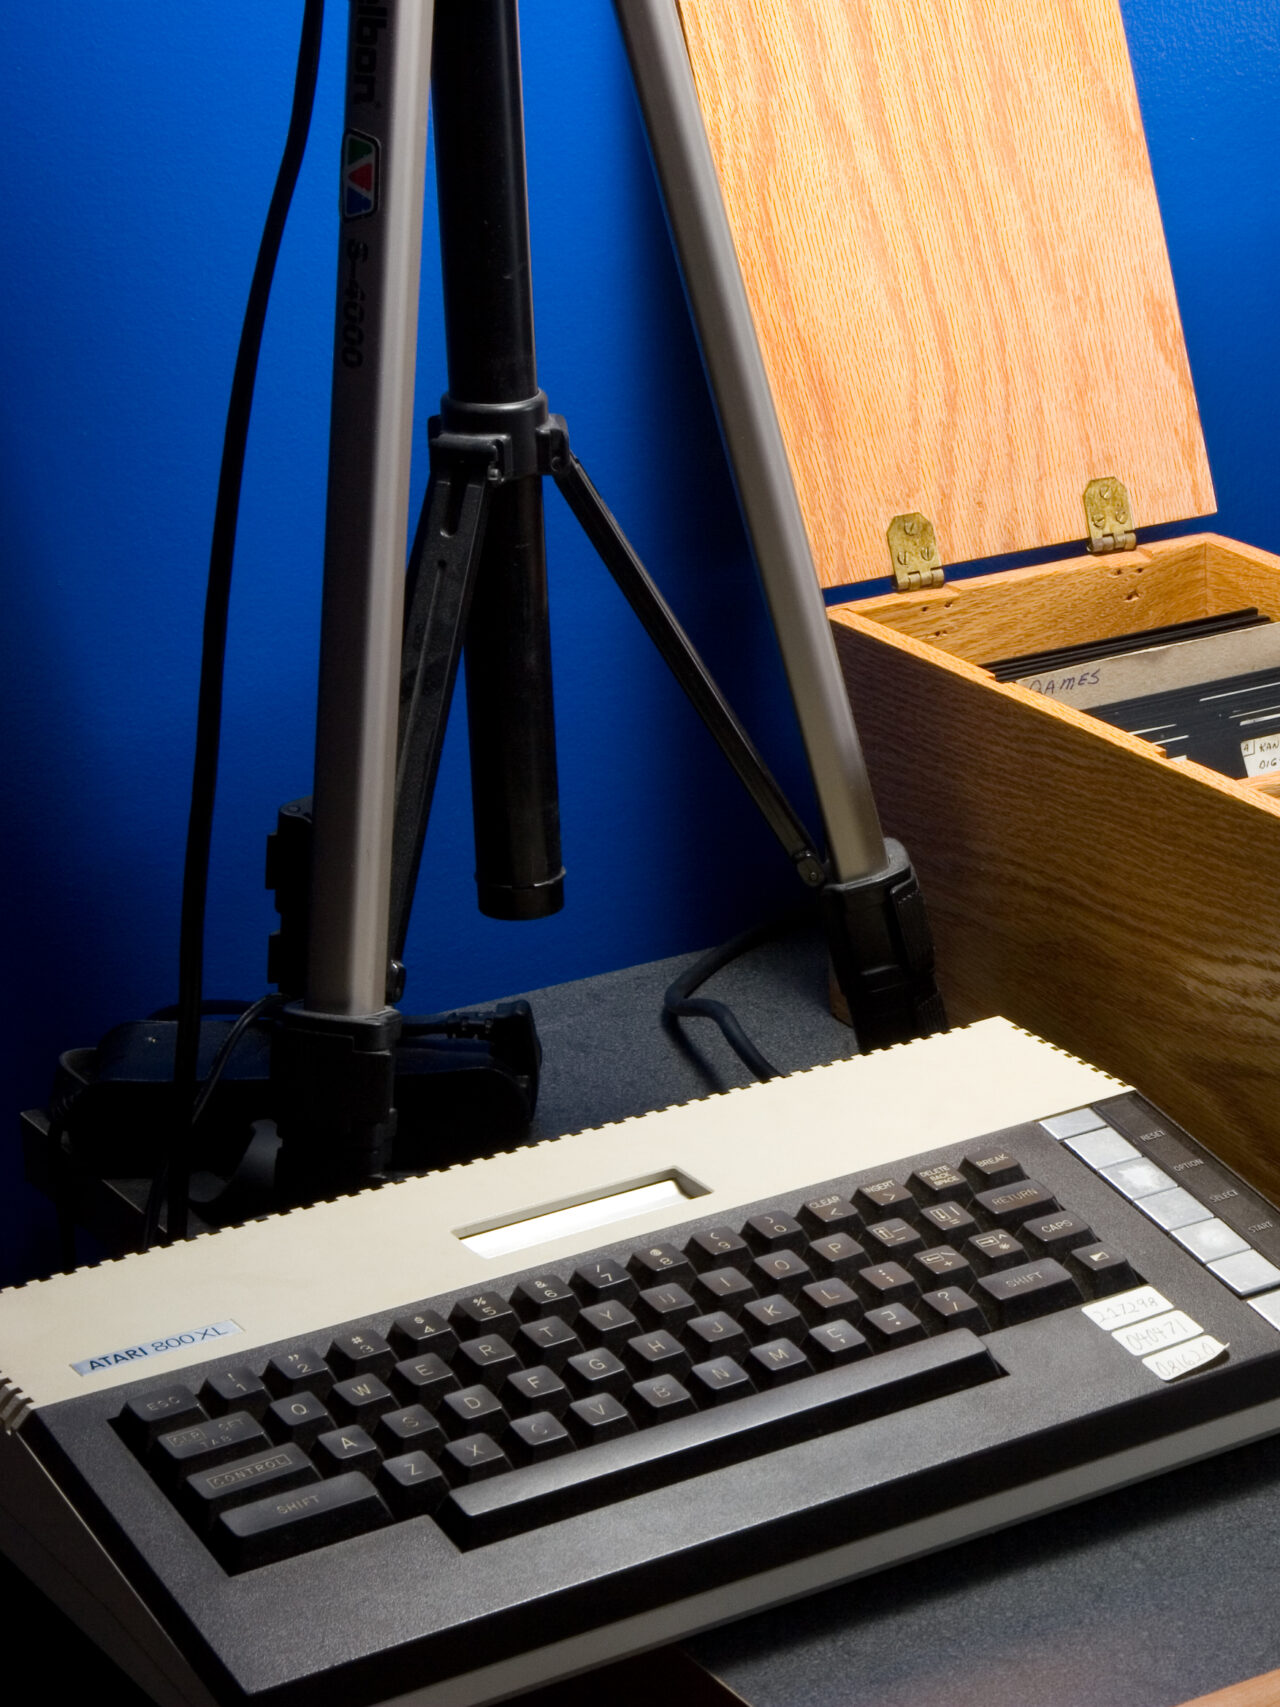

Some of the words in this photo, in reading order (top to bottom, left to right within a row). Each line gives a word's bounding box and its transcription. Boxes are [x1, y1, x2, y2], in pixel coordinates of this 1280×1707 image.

[1140, 1129, 1165, 1142] RESET
[976, 1153, 1008, 1167] BREAK
[1174, 1158, 1204, 1172] OPTION
[920, 1165, 949, 1177] DELETE
[930, 1171, 951, 1181] BACK
[863, 1180, 895, 1193] INSERT
[934, 1175, 960, 1186] SPACE
[809, 1195, 840, 1209] CLEAR
[992, 1188, 1038, 1206] RETURN
[1211, 1189, 1238, 1203] SELECT
[1041, 1219, 1073, 1233] CAPS
[1248, 1220, 1273, 1234] START
[828, 1243, 841, 1253] P
[1005, 1271, 1043, 1288] SHIFT
[821, 1289, 840, 1299] L
[600, 1310, 613, 1321] Y
[763, 1304, 781, 1316] K
[424, 1325, 435, 1333] 4
[539, 1326, 554, 1337] T
[712, 1322, 723, 1333] J
[89, 1347, 149, 1370] ATARI
[151, 1334, 195, 1352] 800
[196, 1327, 228, 1340] XL
[479, 1345, 495, 1356] R
[648, 1340, 665, 1352] H
[768, 1349, 789, 1361] M
[415, 1365, 433, 1376] E
[589, 1360, 607, 1370] G
[712, 1369, 730, 1379] N
[527, 1376, 540, 1388] F
[352, 1384, 371, 1396] W
[653, 1385, 671, 1398] B
[146, 1396, 181, 1411] ESC
[464, 1397, 480, 1409] D
[590, 1404, 605, 1415] V
[341, 1437, 357, 1449] A
[466, 1444, 484, 1457] X
[211, 1456, 289, 1487] CONTROL
[404, 1463, 423, 1475] Z
[276, 1495, 320, 1514] SHIFT
